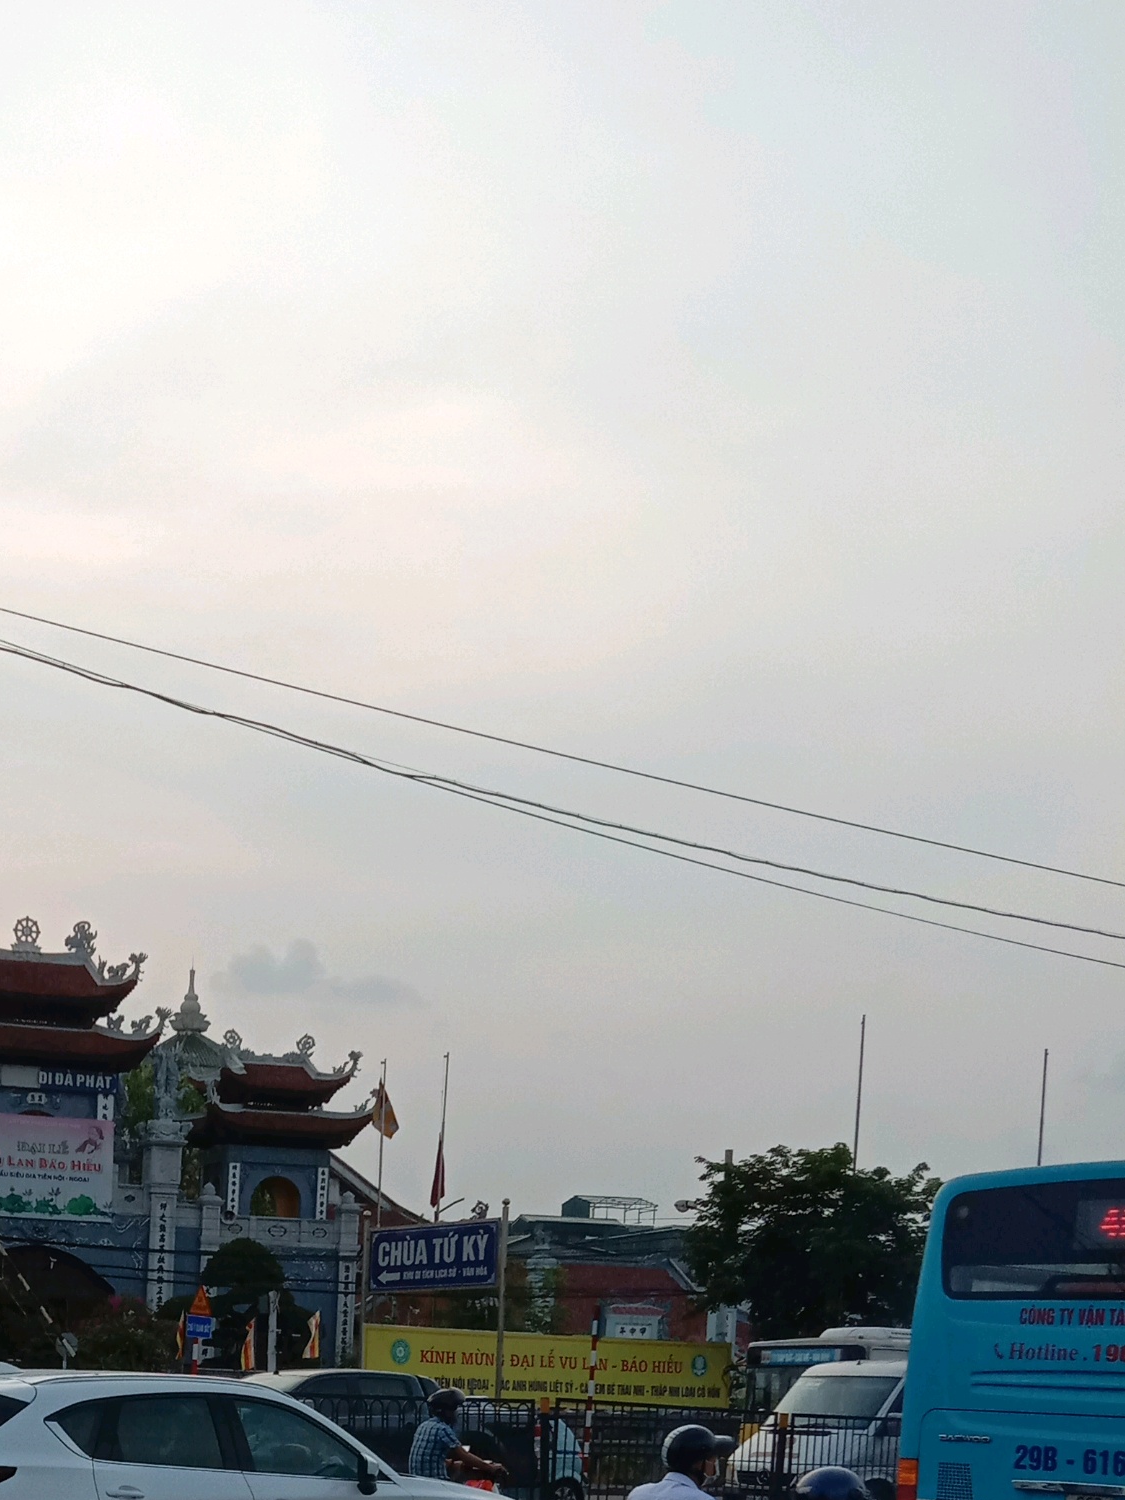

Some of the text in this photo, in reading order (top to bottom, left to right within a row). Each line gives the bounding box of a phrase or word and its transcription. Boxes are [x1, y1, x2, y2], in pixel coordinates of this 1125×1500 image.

[76, 1072, 113, 1091] PHẬT
[7, 1155, 34, 1168] LAN
[377, 1229, 489, 1267] CHÙA TỨ KỲ
[402, 1271, 414, 1280] KHU
[1019, 1304, 1055, 1325] CÔNG
[1059, 1307, 1074, 1325] TY
[1078, 1304, 1106, 1328] VẬN
[420, 1346, 456, 1364] KÍNH
[509, 1353, 535, 1371] ĐẠI
[539, 1348, 556, 1368] LỄ
[559, 1356, 577, 1369] VU
[620, 1355, 648, 1373] BÁO
[651, 1354, 683, 1374] HIẾU
[1008, 1341, 1079, 1361] Hotline
[511, 1380, 527, 1391] ANH
[1013, 1444, 1058, 1472] 29B
